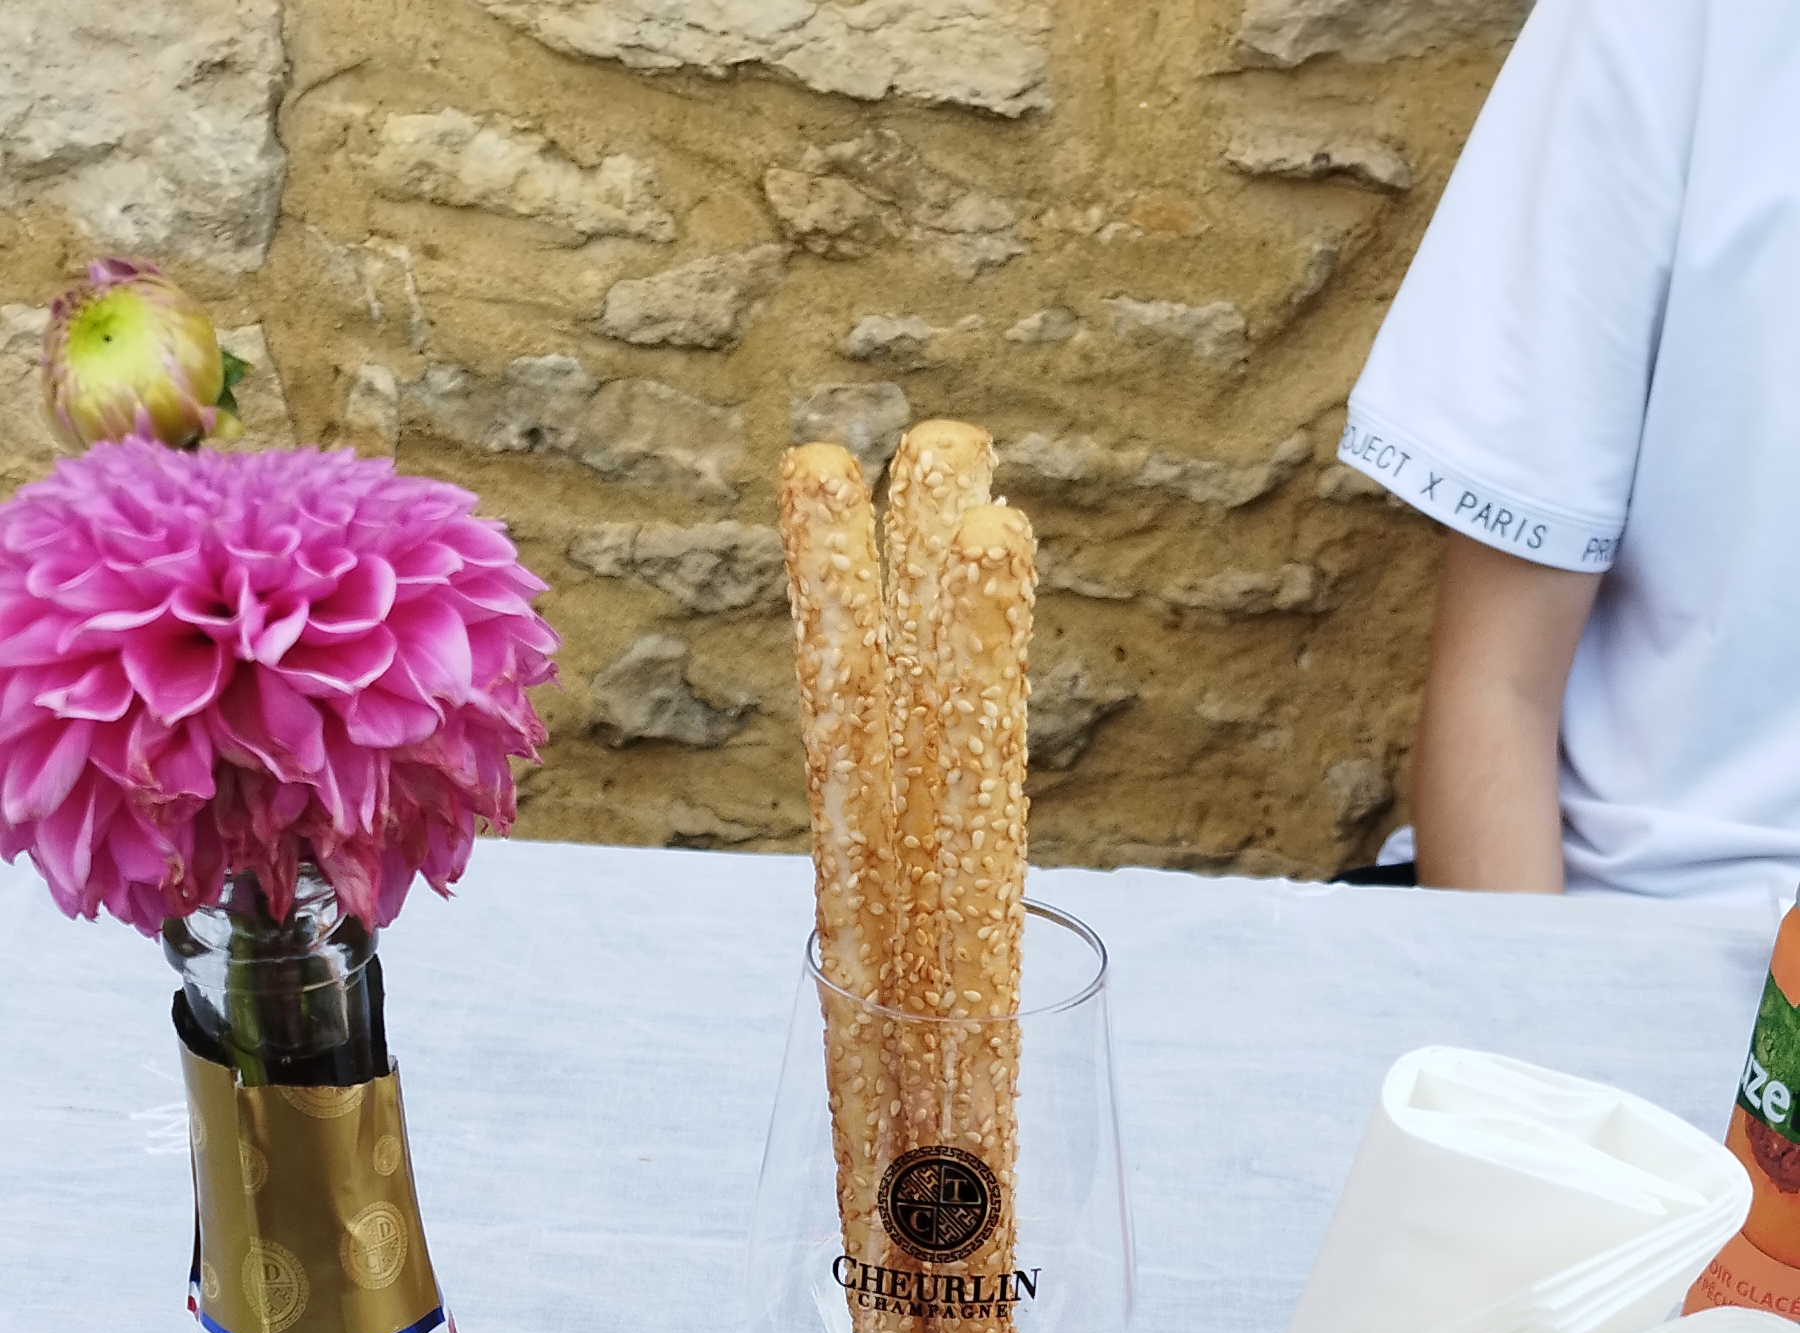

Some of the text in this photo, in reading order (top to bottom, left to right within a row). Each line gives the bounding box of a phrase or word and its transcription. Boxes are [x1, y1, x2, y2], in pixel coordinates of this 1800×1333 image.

[1341, 422, 1412, 477] OJECT
[1420, 471, 1445, 501] X
[1455, 491, 1548, 550] PARIS
[832, 1255, 1042, 1304] CHEURLIN
[857, 1293, 1008, 1320] CHAMPAGNE
